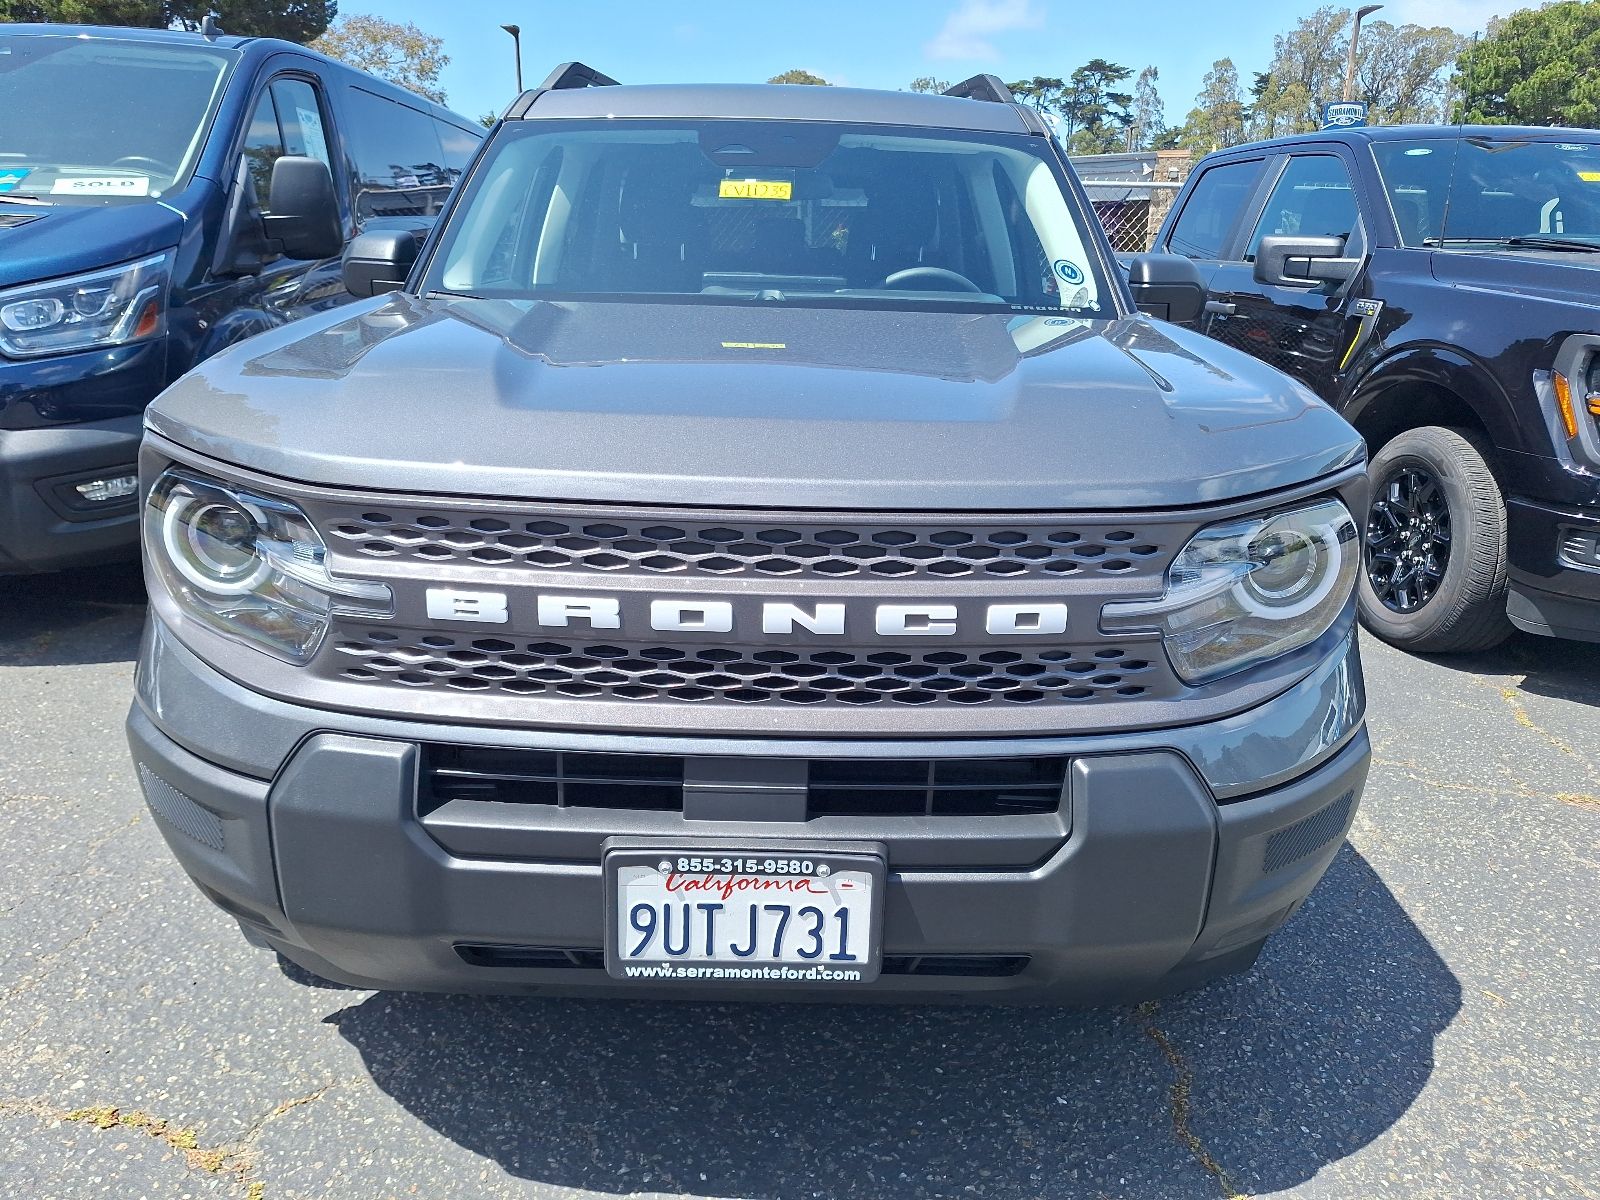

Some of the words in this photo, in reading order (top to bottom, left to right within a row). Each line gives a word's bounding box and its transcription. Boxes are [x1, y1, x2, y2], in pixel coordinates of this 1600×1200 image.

[426, 588, 1068, 636] BRONCO
[677, 858, 814, 874] 855-315-9580
[665, 872, 828, 900] California
[629, 903, 857, 961] 9UTJ731
[625, 964, 861, 981] www.serramonteford.com
